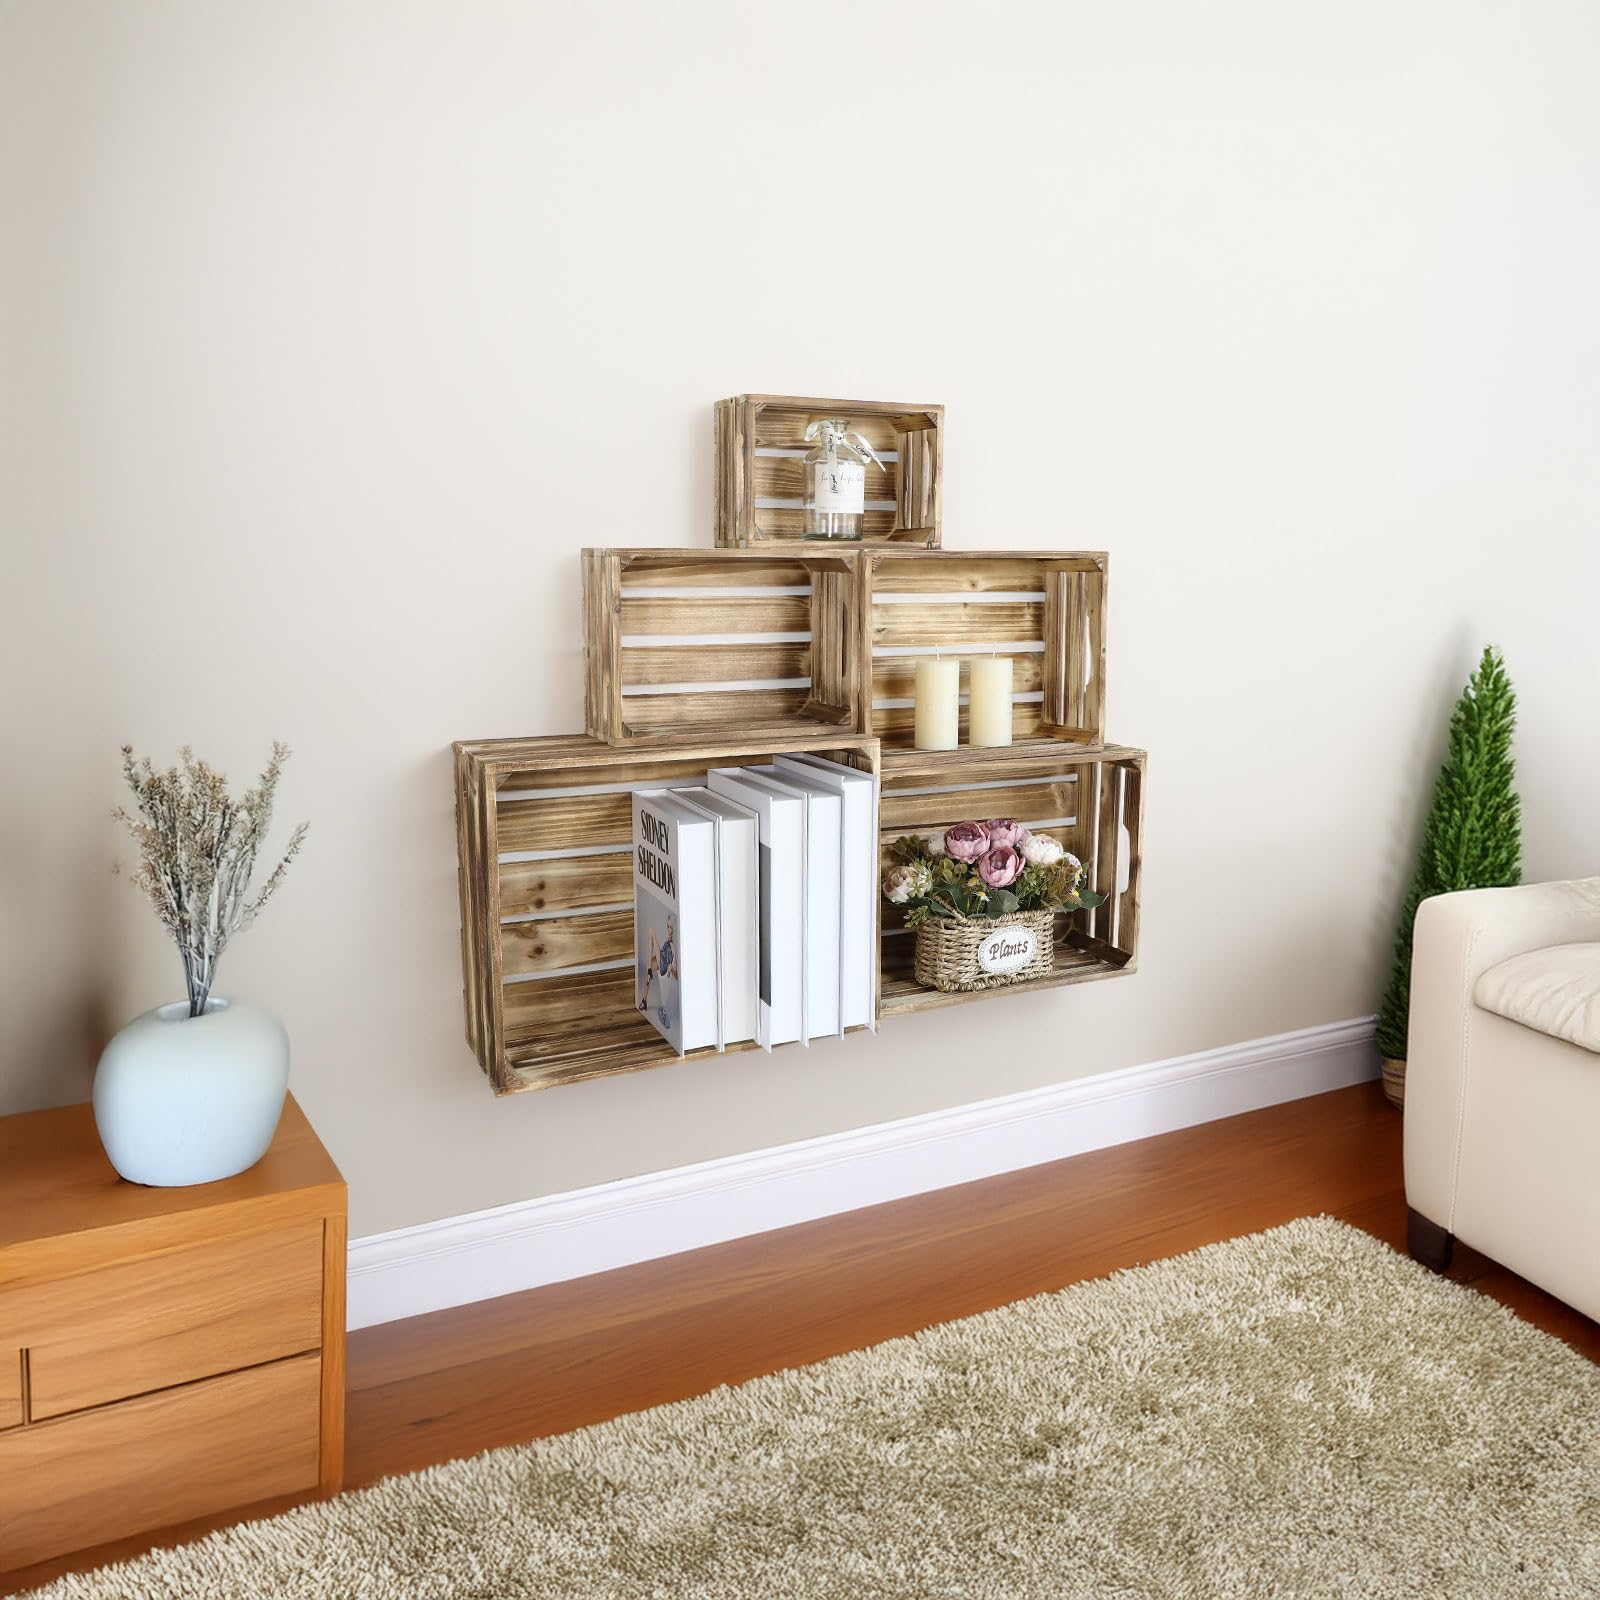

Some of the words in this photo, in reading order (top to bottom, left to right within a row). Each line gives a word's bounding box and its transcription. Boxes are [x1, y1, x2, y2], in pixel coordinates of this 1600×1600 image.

[641, 809, 669, 855] SIDNEY
[638, 844, 676, 900] SHELDON
[989, 939, 1029, 961] Plants
